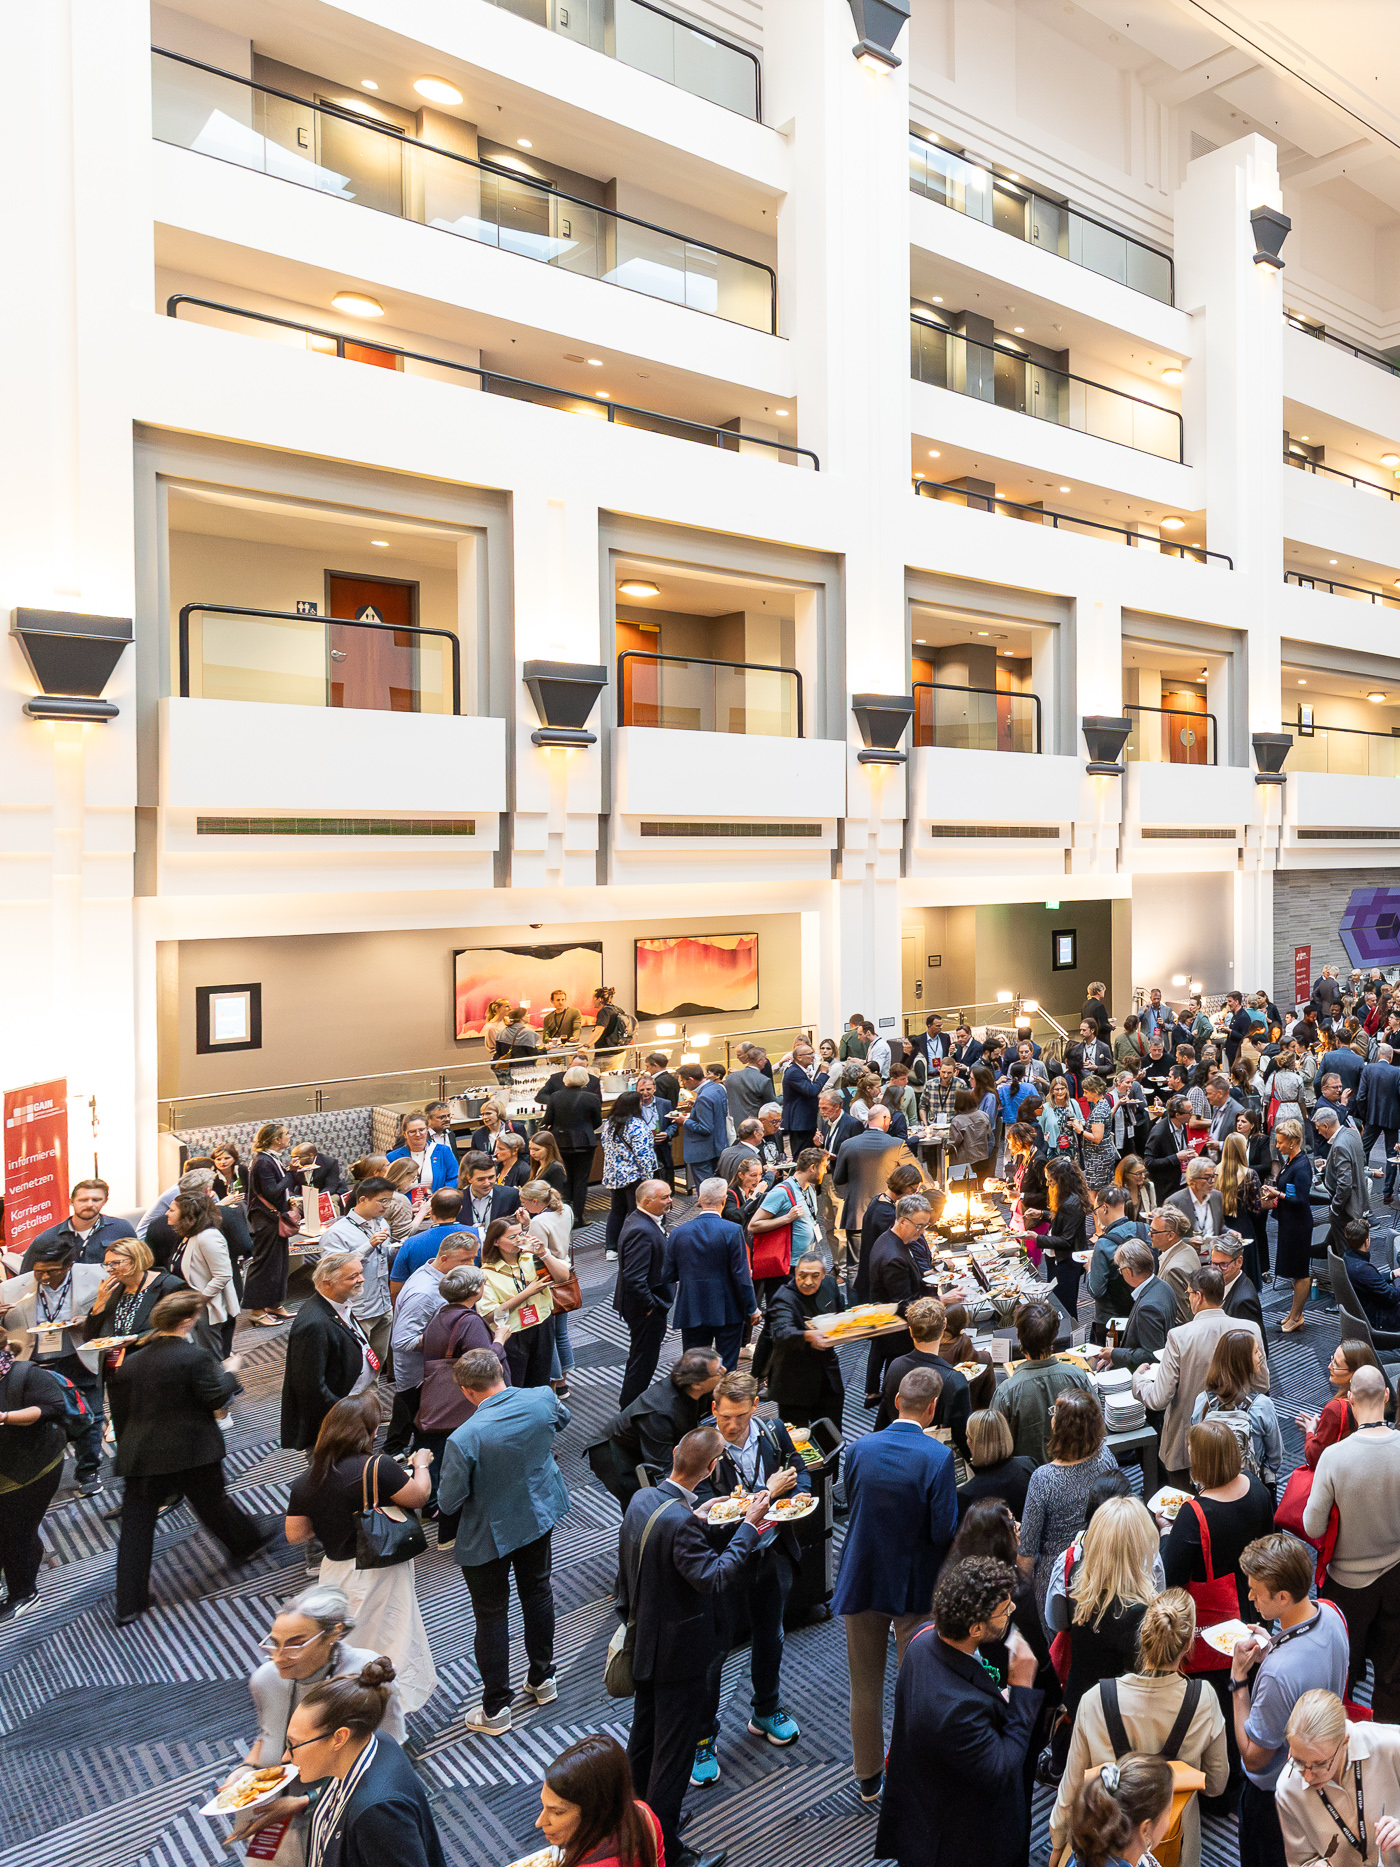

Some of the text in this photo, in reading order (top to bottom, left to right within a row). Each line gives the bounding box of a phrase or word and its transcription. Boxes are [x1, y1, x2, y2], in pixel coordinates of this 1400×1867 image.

[33, 1098, 54, 1112] GAIN
[8, 1147, 58, 1171] informiere
[9, 1172, 54, 1196] vernetzen
[10, 1199, 52, 1222] Karrieren
[10, 1212, 53, 1238] gestalten
